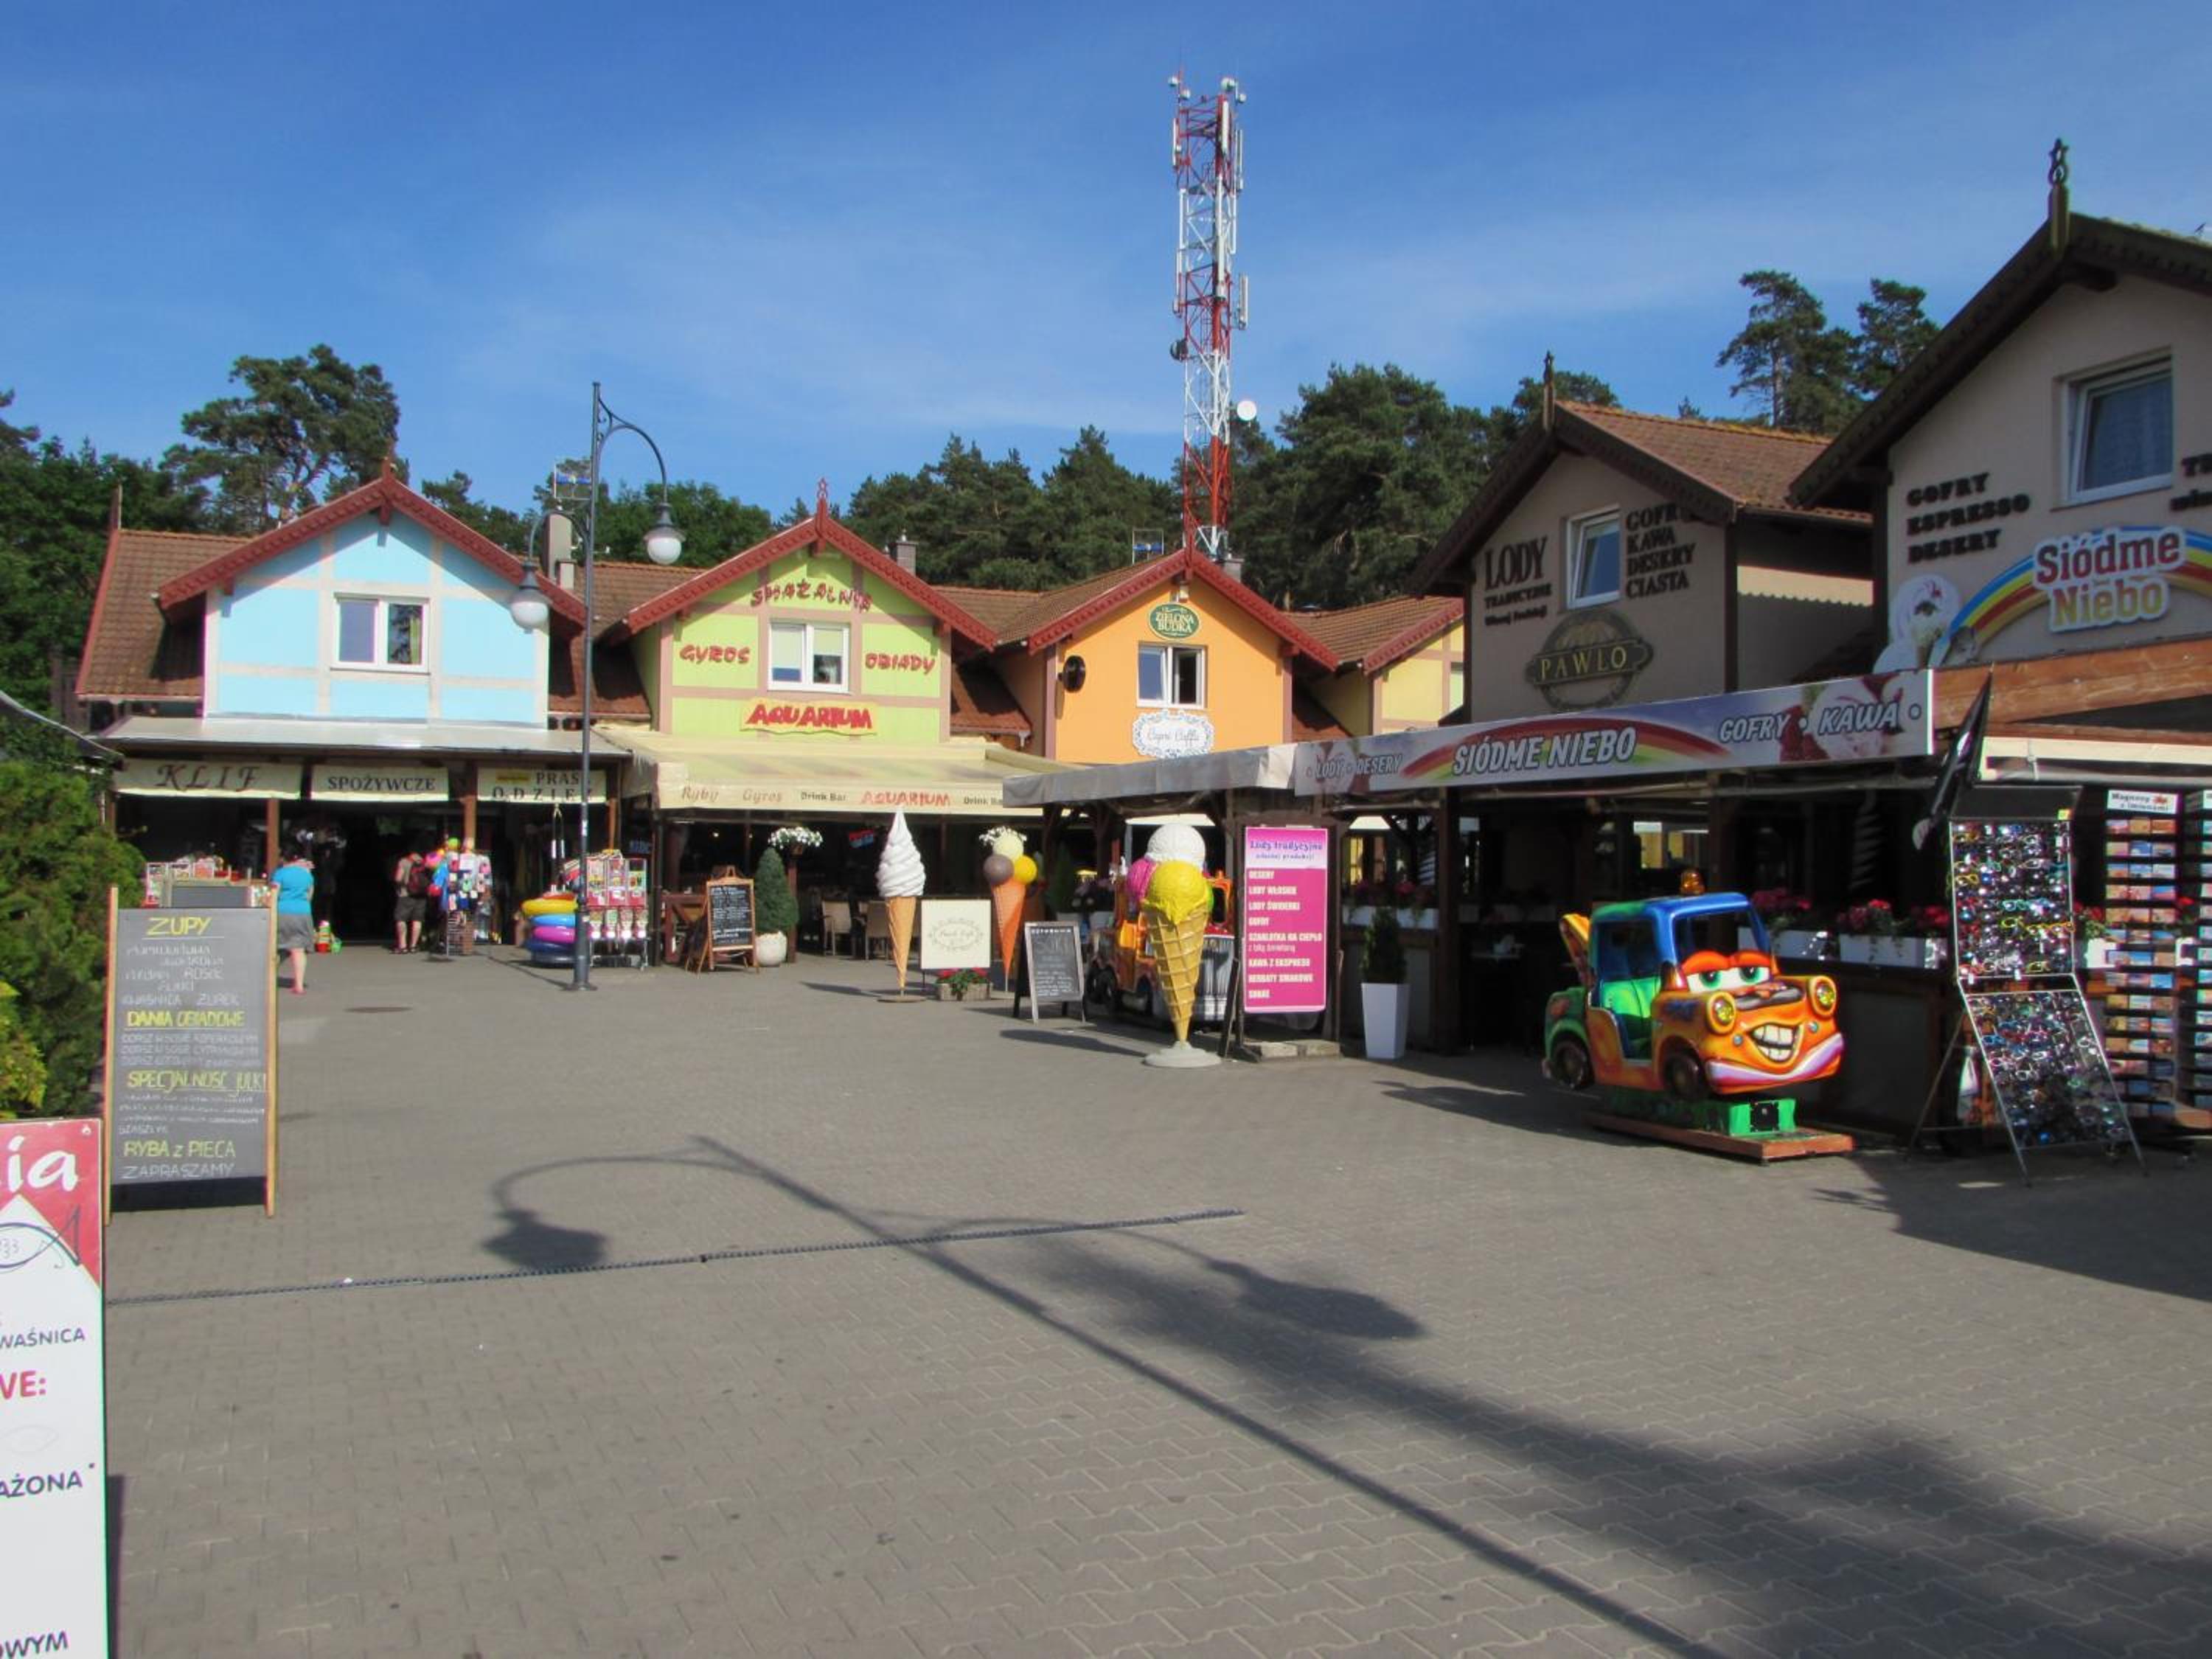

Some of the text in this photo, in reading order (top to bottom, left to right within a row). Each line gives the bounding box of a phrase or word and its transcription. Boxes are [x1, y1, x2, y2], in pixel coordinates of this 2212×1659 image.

[1907, 472, 1989, 507] GOFRY
[1907, 493, 2031, 536] ESPRESSO
[1627, 526, 1676, 554] KAWA
[1907, 528, 2002, 564] DESERY
[1484, 535, 1548, 591] LODY
[1627, 543, 1696, 577] DESERY
[2036, 531, 2181, 585] Siódme
[1627, 569, 1690, 599] CIASTA
[2052, 578, 2163, 626] Niebo
[679, 643, 751, 665] GYROS
[865, 653, 936, 675] OBIADY
[745, 703, 873, 729] AQUARIUM
[1719, 701, 1901, 743] GOFRY KAWA
[1356, 753, 1402, 776] DESERY
[1452, 726, 1637, 776] SIÓDME NIEBO
[156, 762, 260, 793] KLIF
[536, 772, 590, 787] PRAS
[681, 785, 719, 804] Ryby
[742, 787, 783, 804] Gyros
[801, 790, 827, 801] Drink
[830, 791, 846, 801] Bar
[861, 790, 950, 807] AQUARIUM
[147, 916, 213, 937] ZUPY
[127, 1009, 247, 1027] DANIA OBIADOWE
[124, 1140, 170, 1158] RYBA
[188, 1140, 236, 1158] PIECA
[122, 1163, 235, 1180] ZAPRASZAMY
